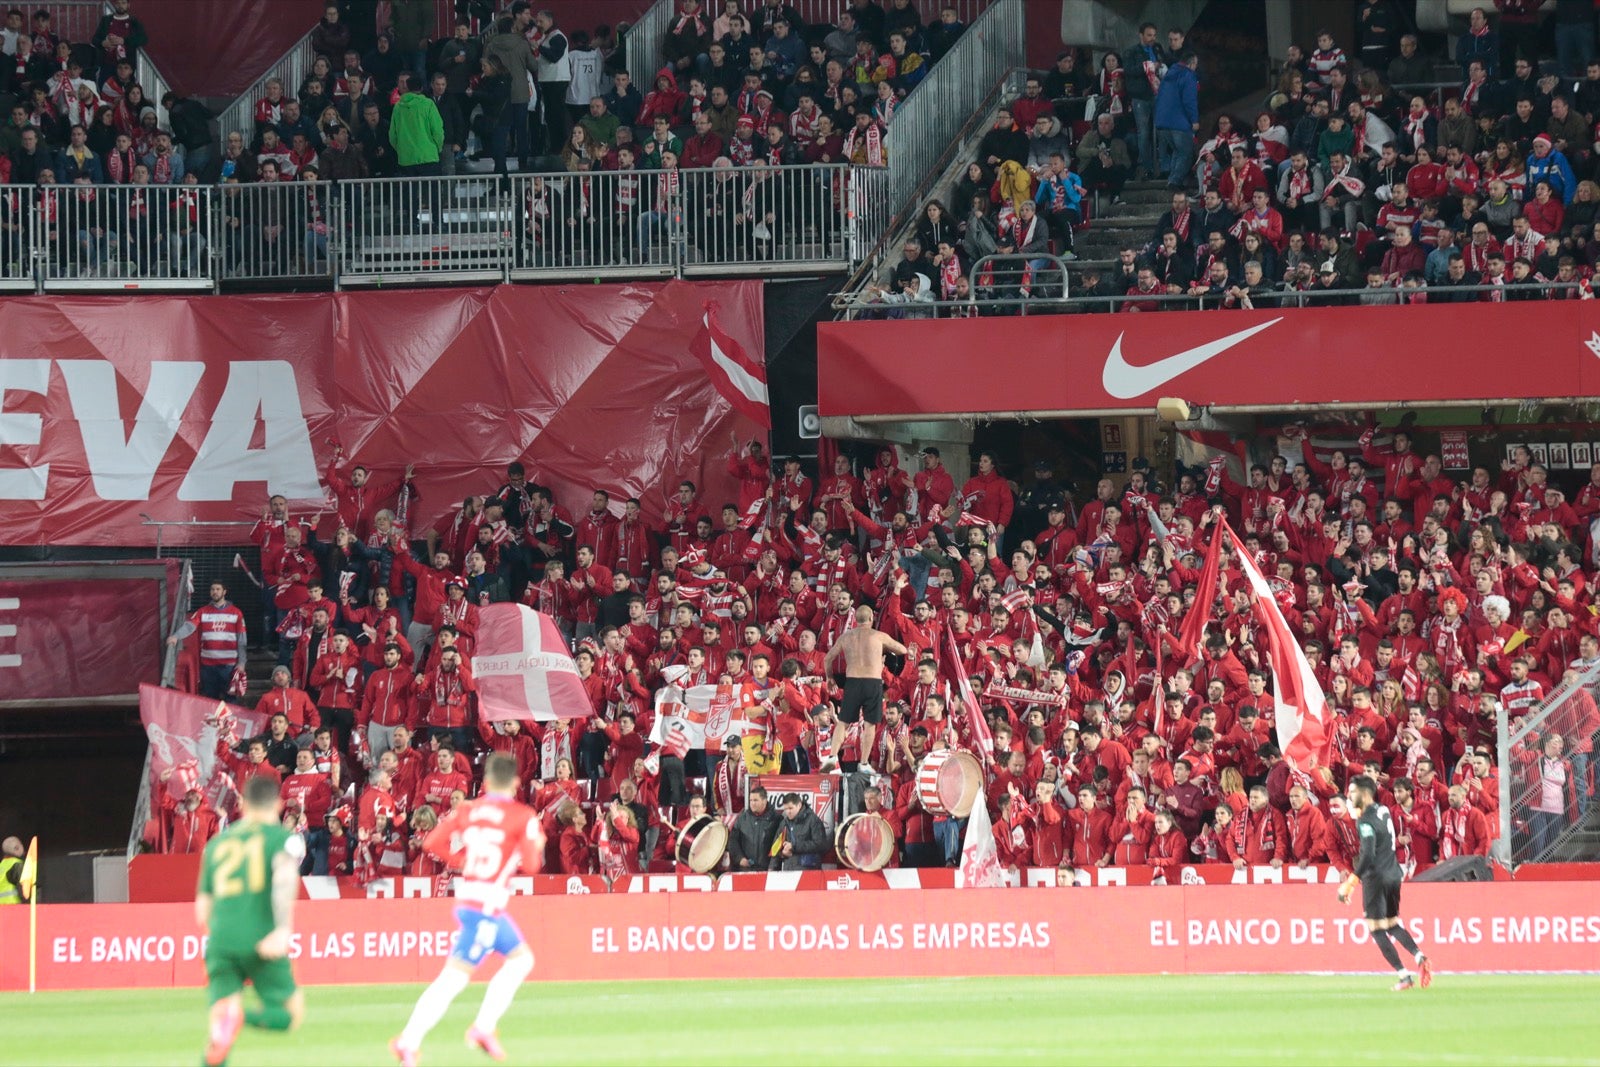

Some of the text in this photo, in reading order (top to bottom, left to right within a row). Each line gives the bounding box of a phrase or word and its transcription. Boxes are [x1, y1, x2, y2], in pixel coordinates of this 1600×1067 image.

[582, 64, 593, 73] 73
[213, 834, 265, 898] 21
[462, 826, 505, 879] 15
[591, 921, 1050, 953] EL BANCO DE TODAS LAS EMPRESAS
[1150, 915, 1600, 946] EL BANCO DE TOS LAS EMPRES
[53, 937, 83, 962] EL
[91, 935, 175, 962] BANCO
[310, 932, 356, 958] LAS
